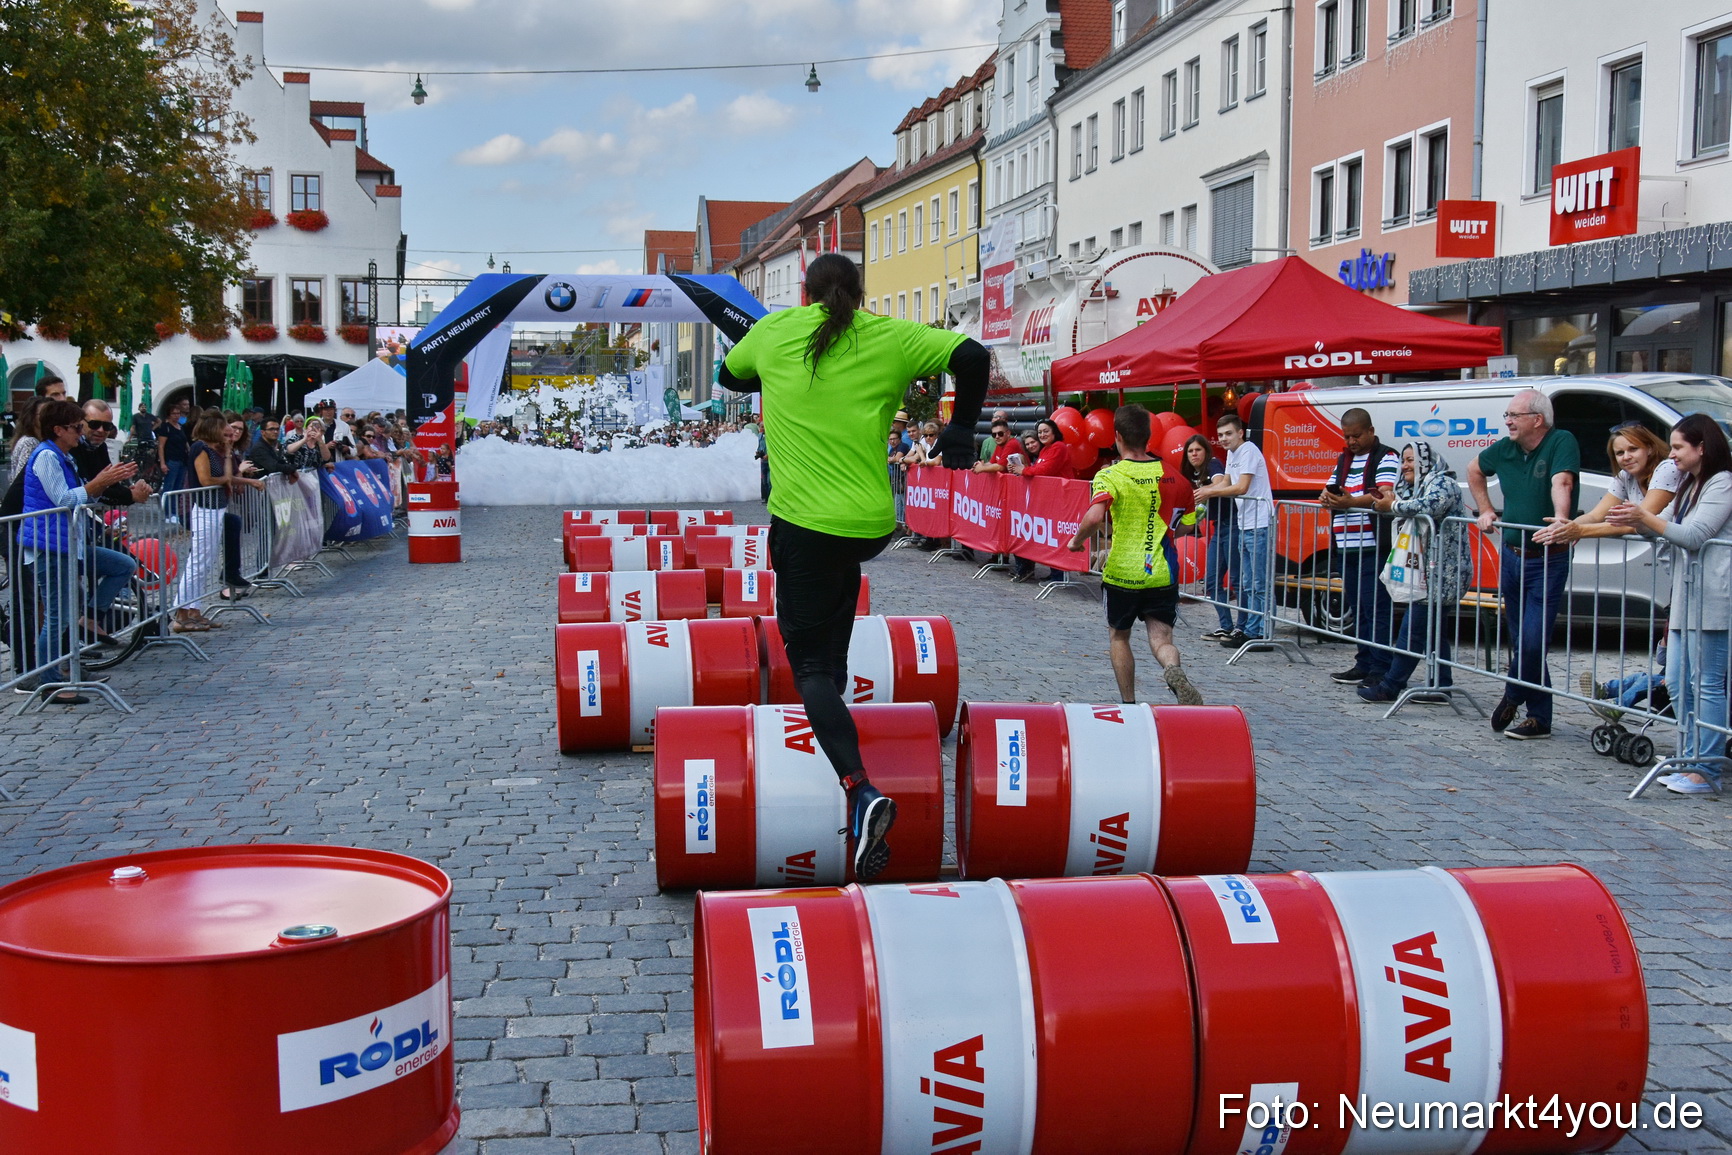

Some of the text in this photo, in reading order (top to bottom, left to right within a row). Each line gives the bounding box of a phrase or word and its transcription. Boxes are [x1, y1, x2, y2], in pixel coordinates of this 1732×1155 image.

[1555, 166, 1613, 215] WITT
[1450, 219, 1488, 234] WITT
[1574, 213, 1606, 229] weiden
[723, 307, 748, 328] PARTL
[421, 305, 492, 355] PARTL NEUMARKT
[1371, 346, 1412, 357] energie
[1284, 423, 1317, 434] Sanitär
[1283, 437, 1320, 448] Heizung
[1447, 435, 1498, 448] energie
[1283, 450, 1344, 460] 24-h-Notdien
[1283, 464, 1336, 475] Energiebera
[1130, 477, 1153, 485] Team
[1057, 516, 1081, 536] energi
[1144, 489, 1157, 552] Motorsport
[790, 921, 804, 962] energie
[395, 1044, 439, 1077] energie
